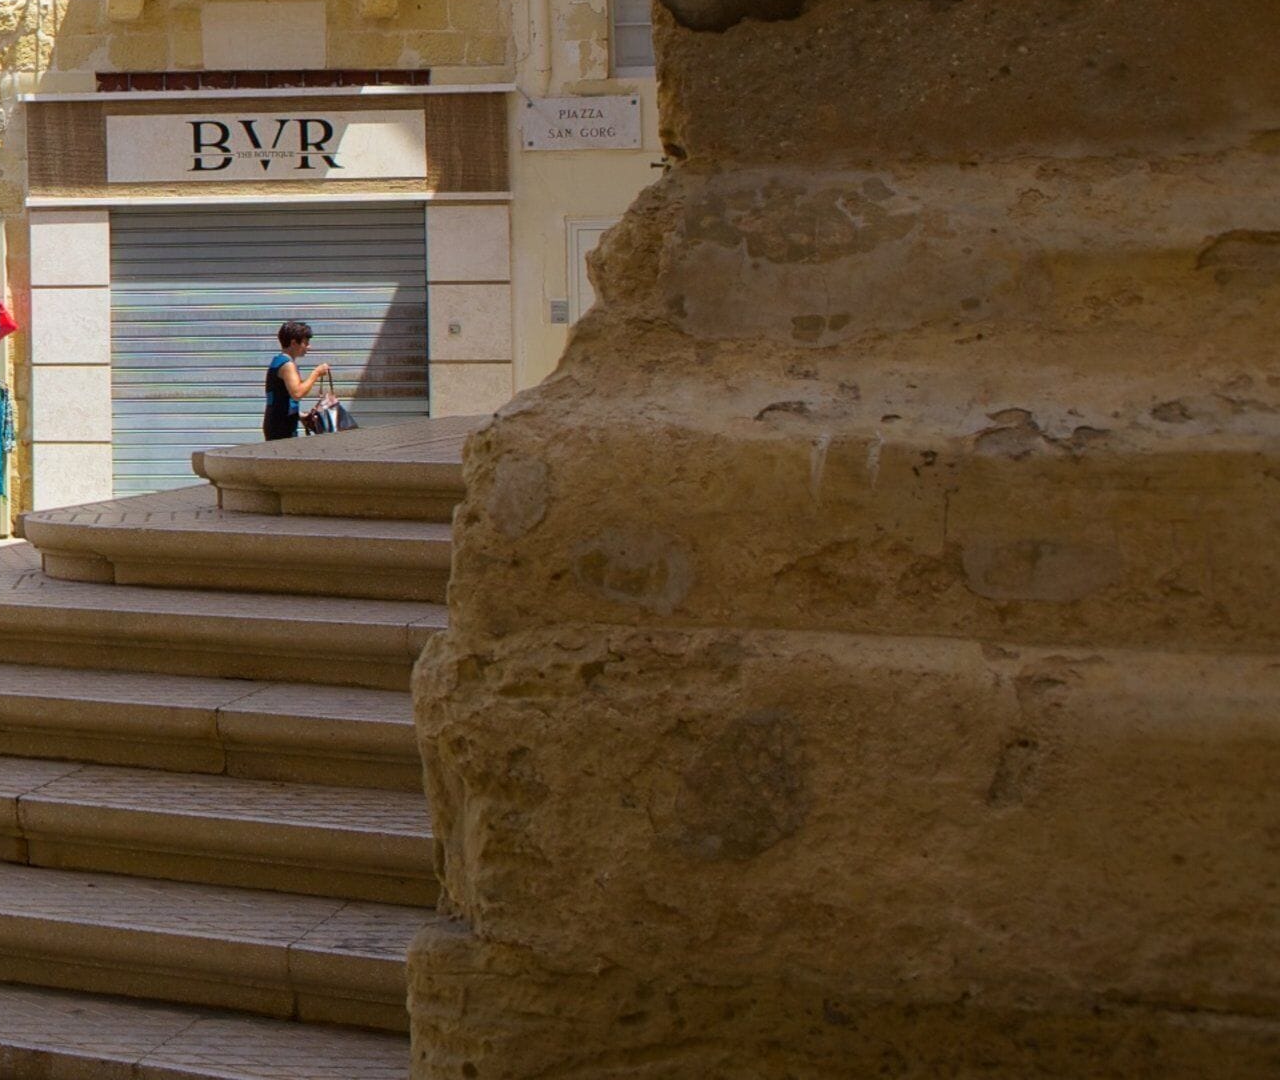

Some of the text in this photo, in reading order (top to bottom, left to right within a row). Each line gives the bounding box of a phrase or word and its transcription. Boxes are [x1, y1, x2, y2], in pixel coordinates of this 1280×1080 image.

[558, 108, 604, 120] PIAZZA
[547, 128, 573, 139] SAN
[185, 118, 345, 172] BVR
[254, 150, 295, 159] BOUTIQUE
